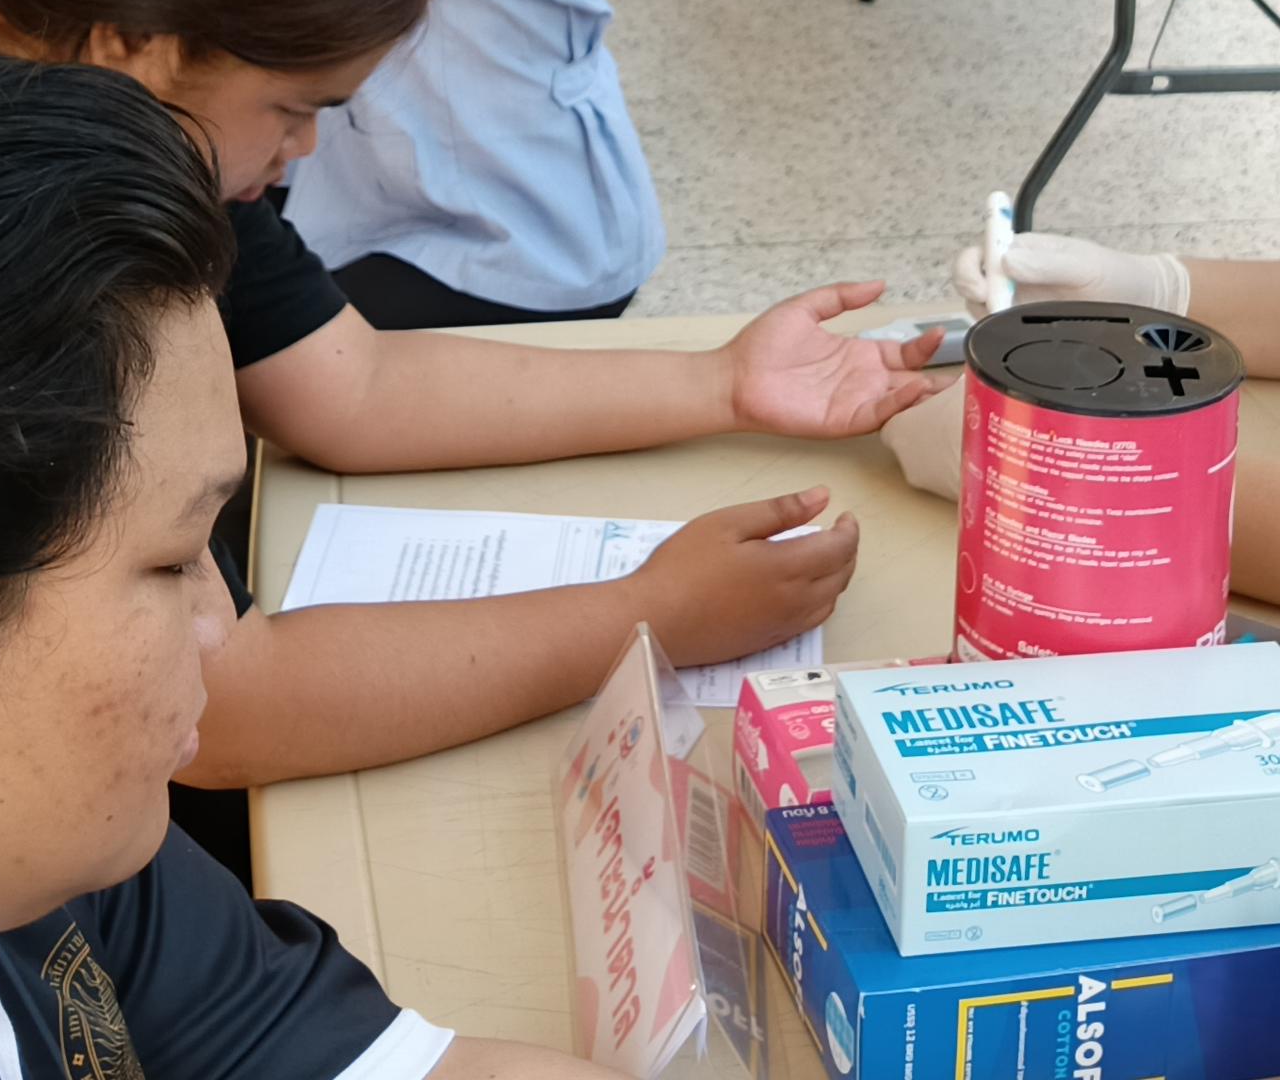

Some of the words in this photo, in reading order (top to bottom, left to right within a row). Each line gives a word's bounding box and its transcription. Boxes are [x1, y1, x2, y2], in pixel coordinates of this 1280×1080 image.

[897, 680, 1015, 696] TERUMO
[881, 698, 1066, 735] MEDISAFE
[982, 723, 1132, 751] FINETOUCH
[947, 829, 1040, 847] TERUMO
[926, 852, 1052, 888] MEDISAFE
[986, 885, 1088, 908] FINETOUCH
